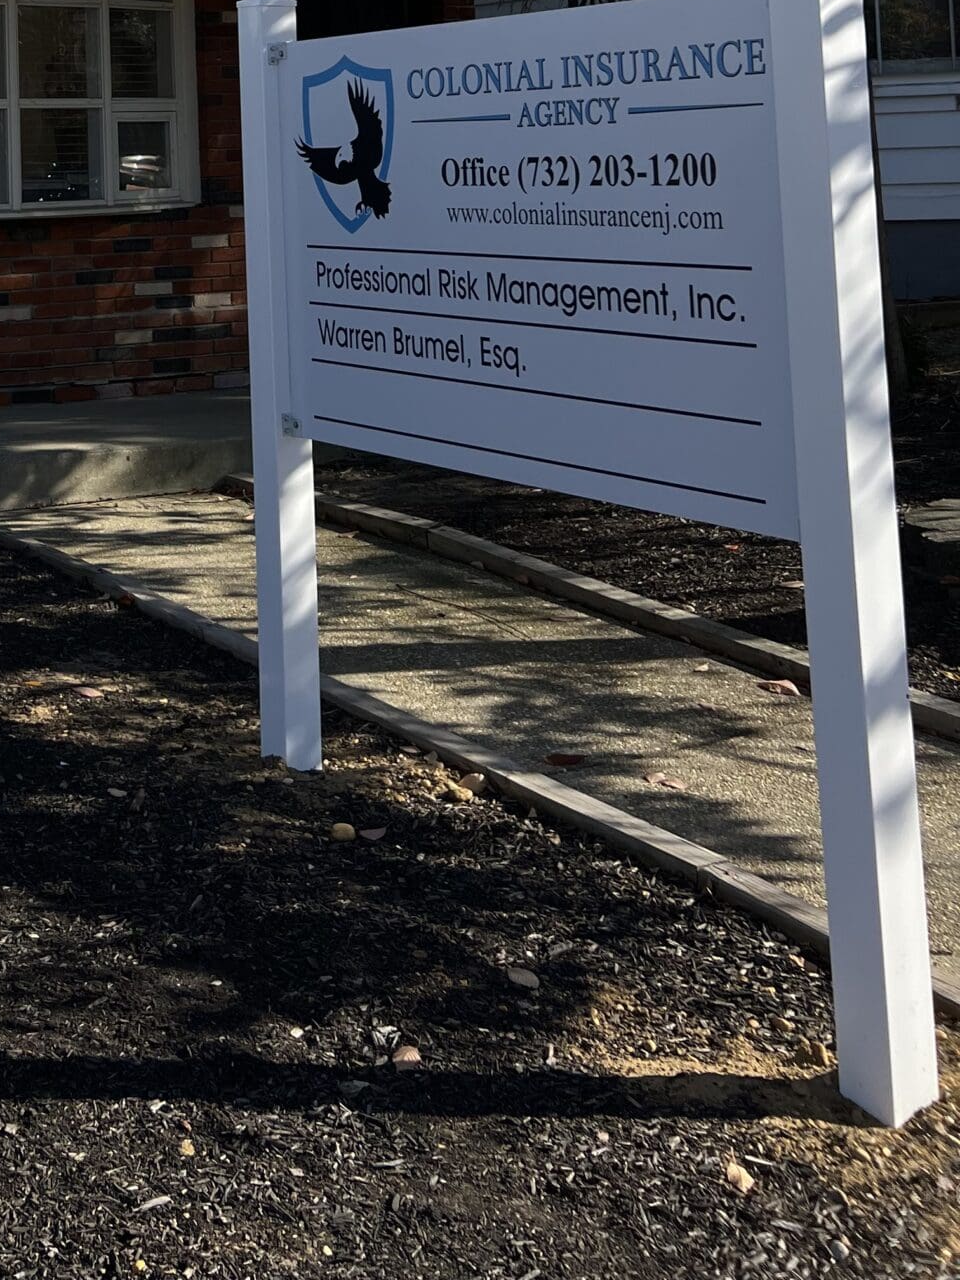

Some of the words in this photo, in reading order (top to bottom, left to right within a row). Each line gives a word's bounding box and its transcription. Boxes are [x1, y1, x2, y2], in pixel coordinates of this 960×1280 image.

[406, 57, 554, 99] COLONIAL
[560, 38, 767, 89] INSURANCE
[516, 97, 620, 128] AGENCY
[441, 157, 510, 187] Office
[517, 155, 580, 194] (732)
[588, 152, 717, 187] 203-1200
[446, 201, 724, 235] www.colonialinsurancenj.com
[316, 261, 431, 297] Professional
[438, 268, 480, 301] Risk
[486, 271, 677, 321] Management,
[688, 283, 746, 322] Inc.
[317, 318, 386, 353] Warren
[393, 326, 471, 368] Brumel,
[480, 336, 527, 378] Esq.
